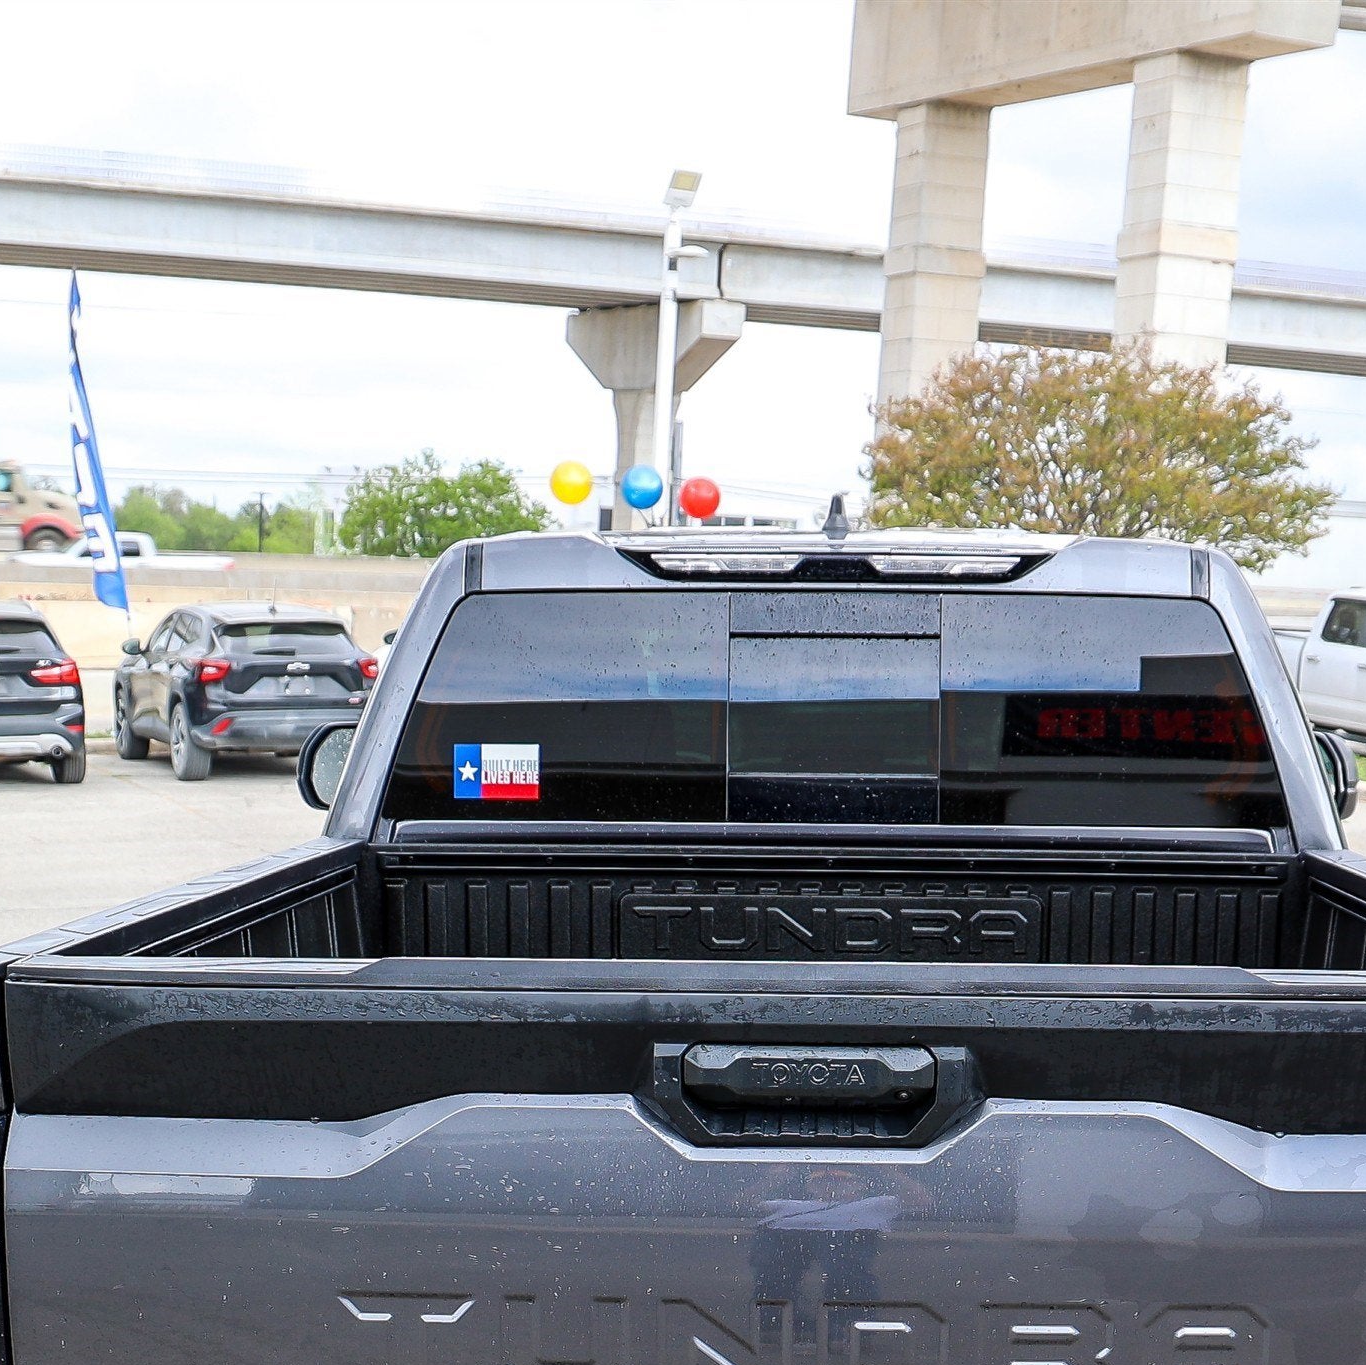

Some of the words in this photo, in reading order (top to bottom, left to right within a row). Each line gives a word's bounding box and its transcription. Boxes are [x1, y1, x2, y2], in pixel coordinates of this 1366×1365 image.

[482, 760, 511, 771] BUILT
[513, 760, 539, 771] HERE
[482, 771, 510, 784] LIVES
[513, 771, 539, 784] HERE
[633, 906, 1029, 955] TUNDRA
[751, 1062, 867, 1086] TOYOTA
